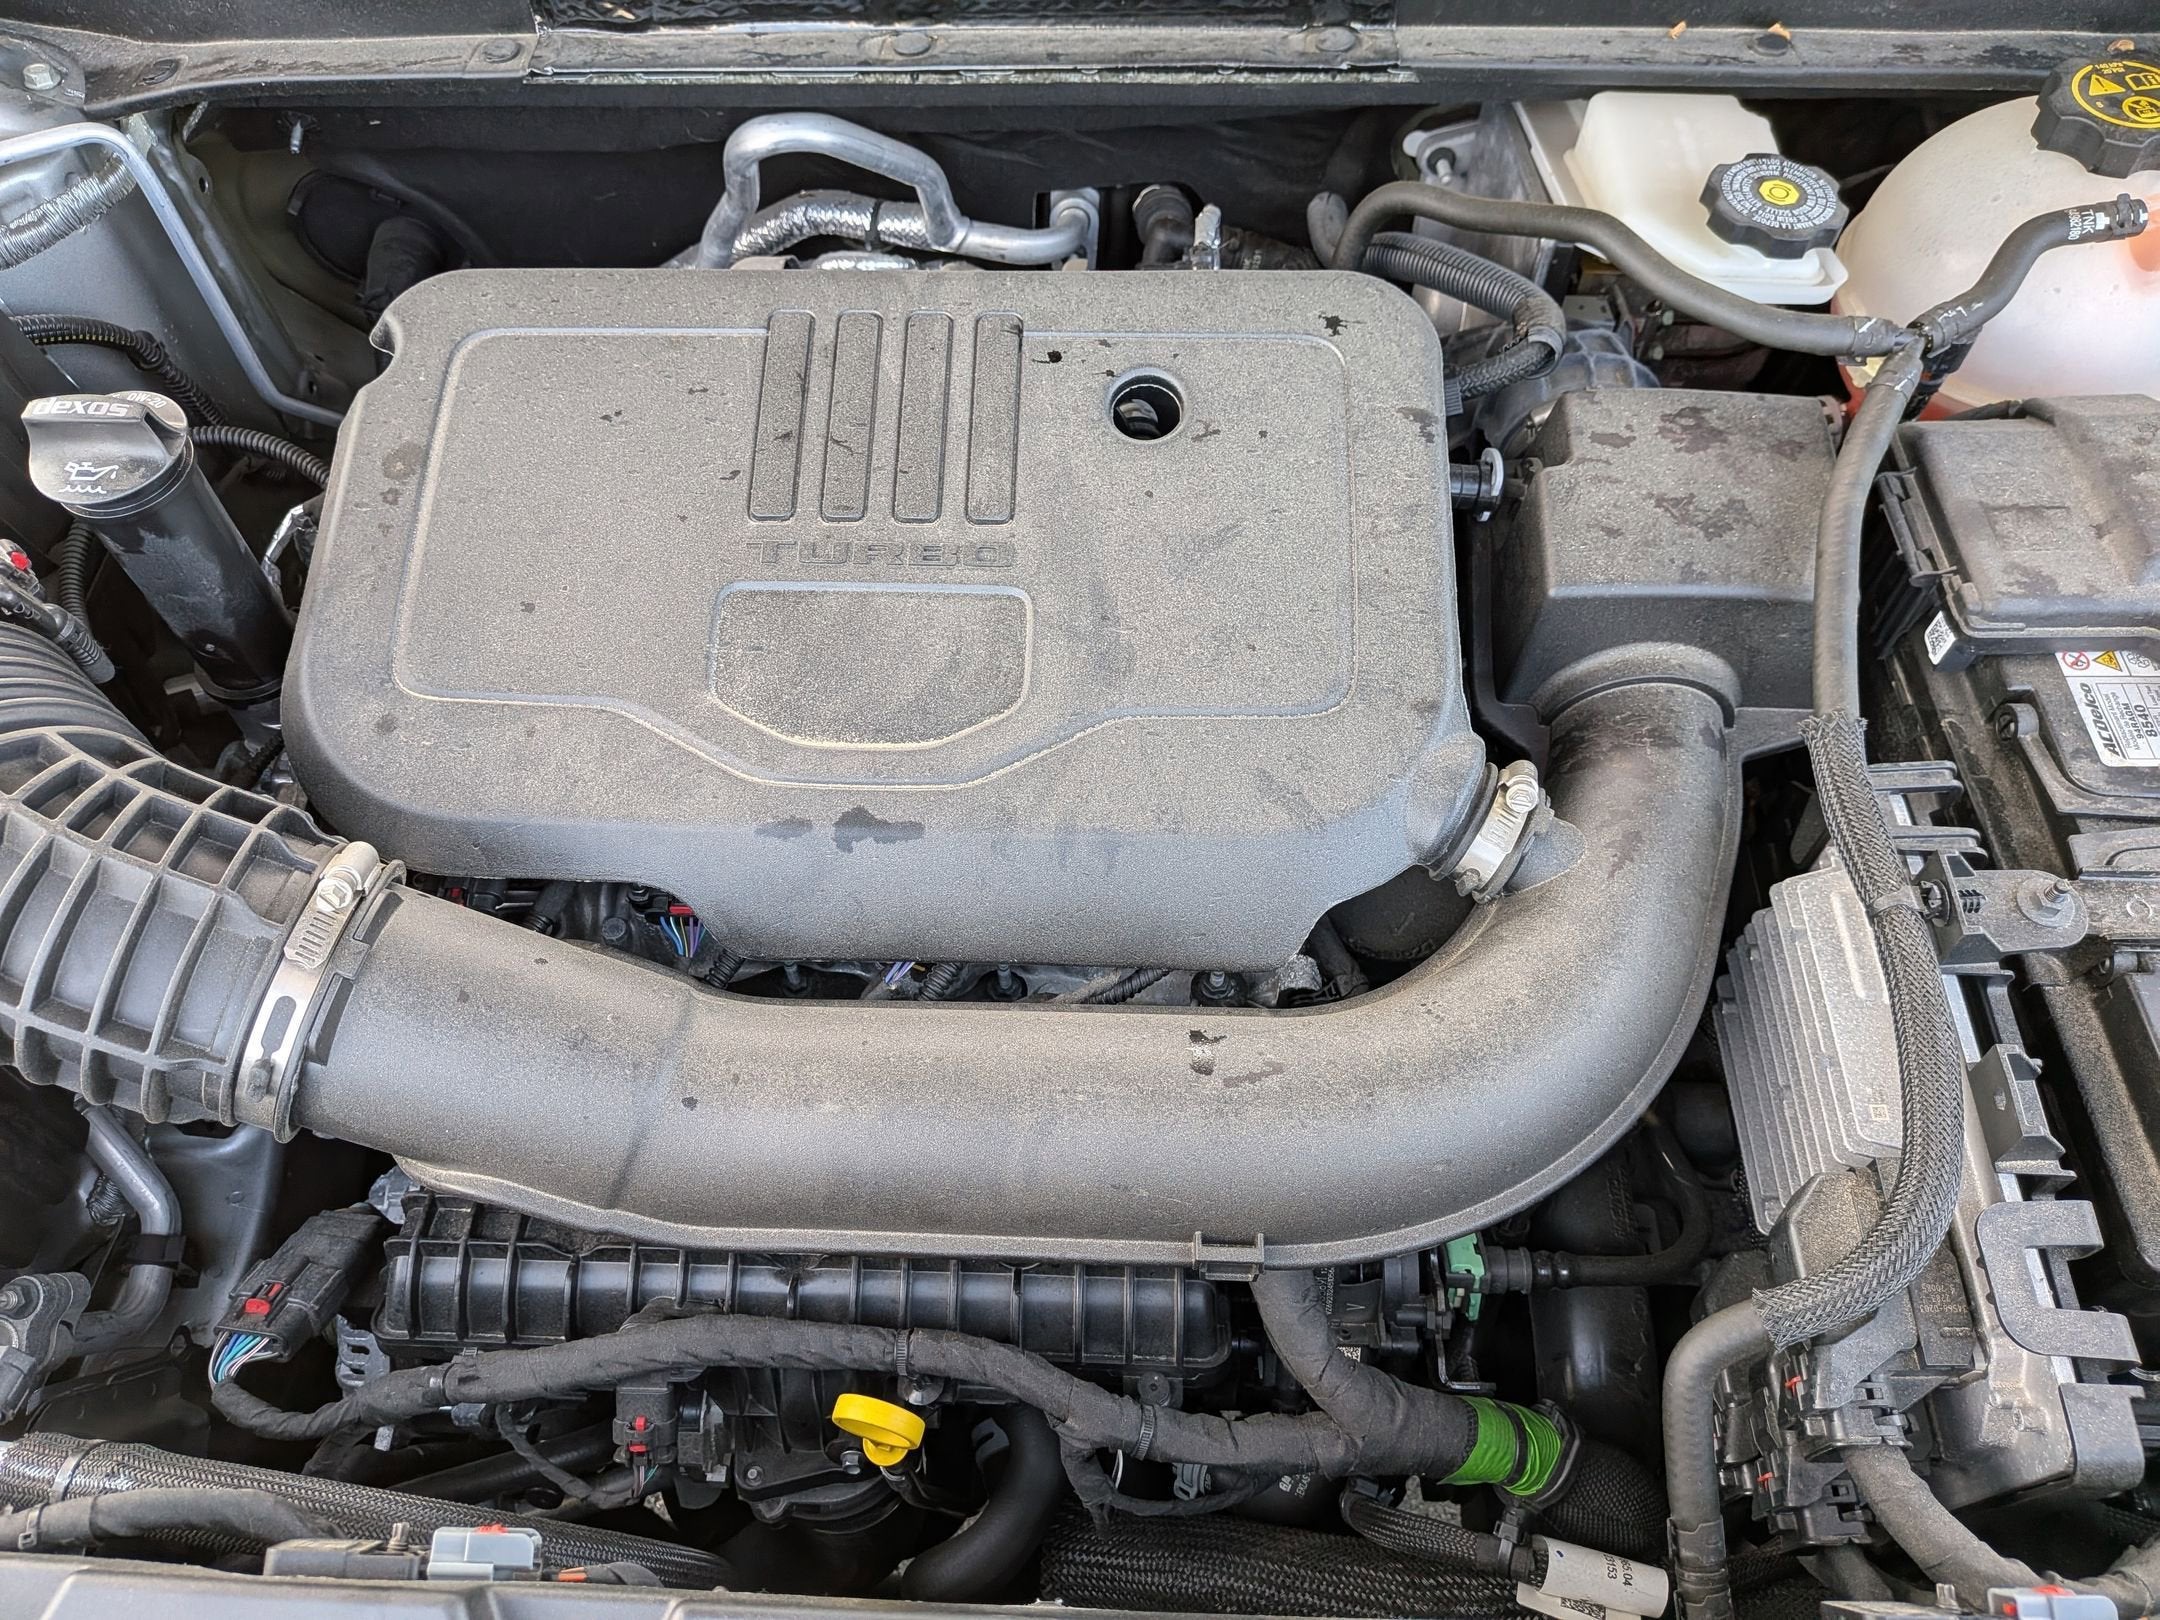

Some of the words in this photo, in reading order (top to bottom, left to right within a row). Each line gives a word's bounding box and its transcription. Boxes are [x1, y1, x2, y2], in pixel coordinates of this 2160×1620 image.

[2081, 209, 2095, 235] TNK
[32, 397, 129, 417] dexos
[127, 392, 167, 409] 0W-20
[746, 540, 1015, 567] TURBO
[2080, 682, 2121, 757] ACDelco
[2121, 703, 2145, 739] 94RAGM
[2134, 704, 2158, 738] 8540
